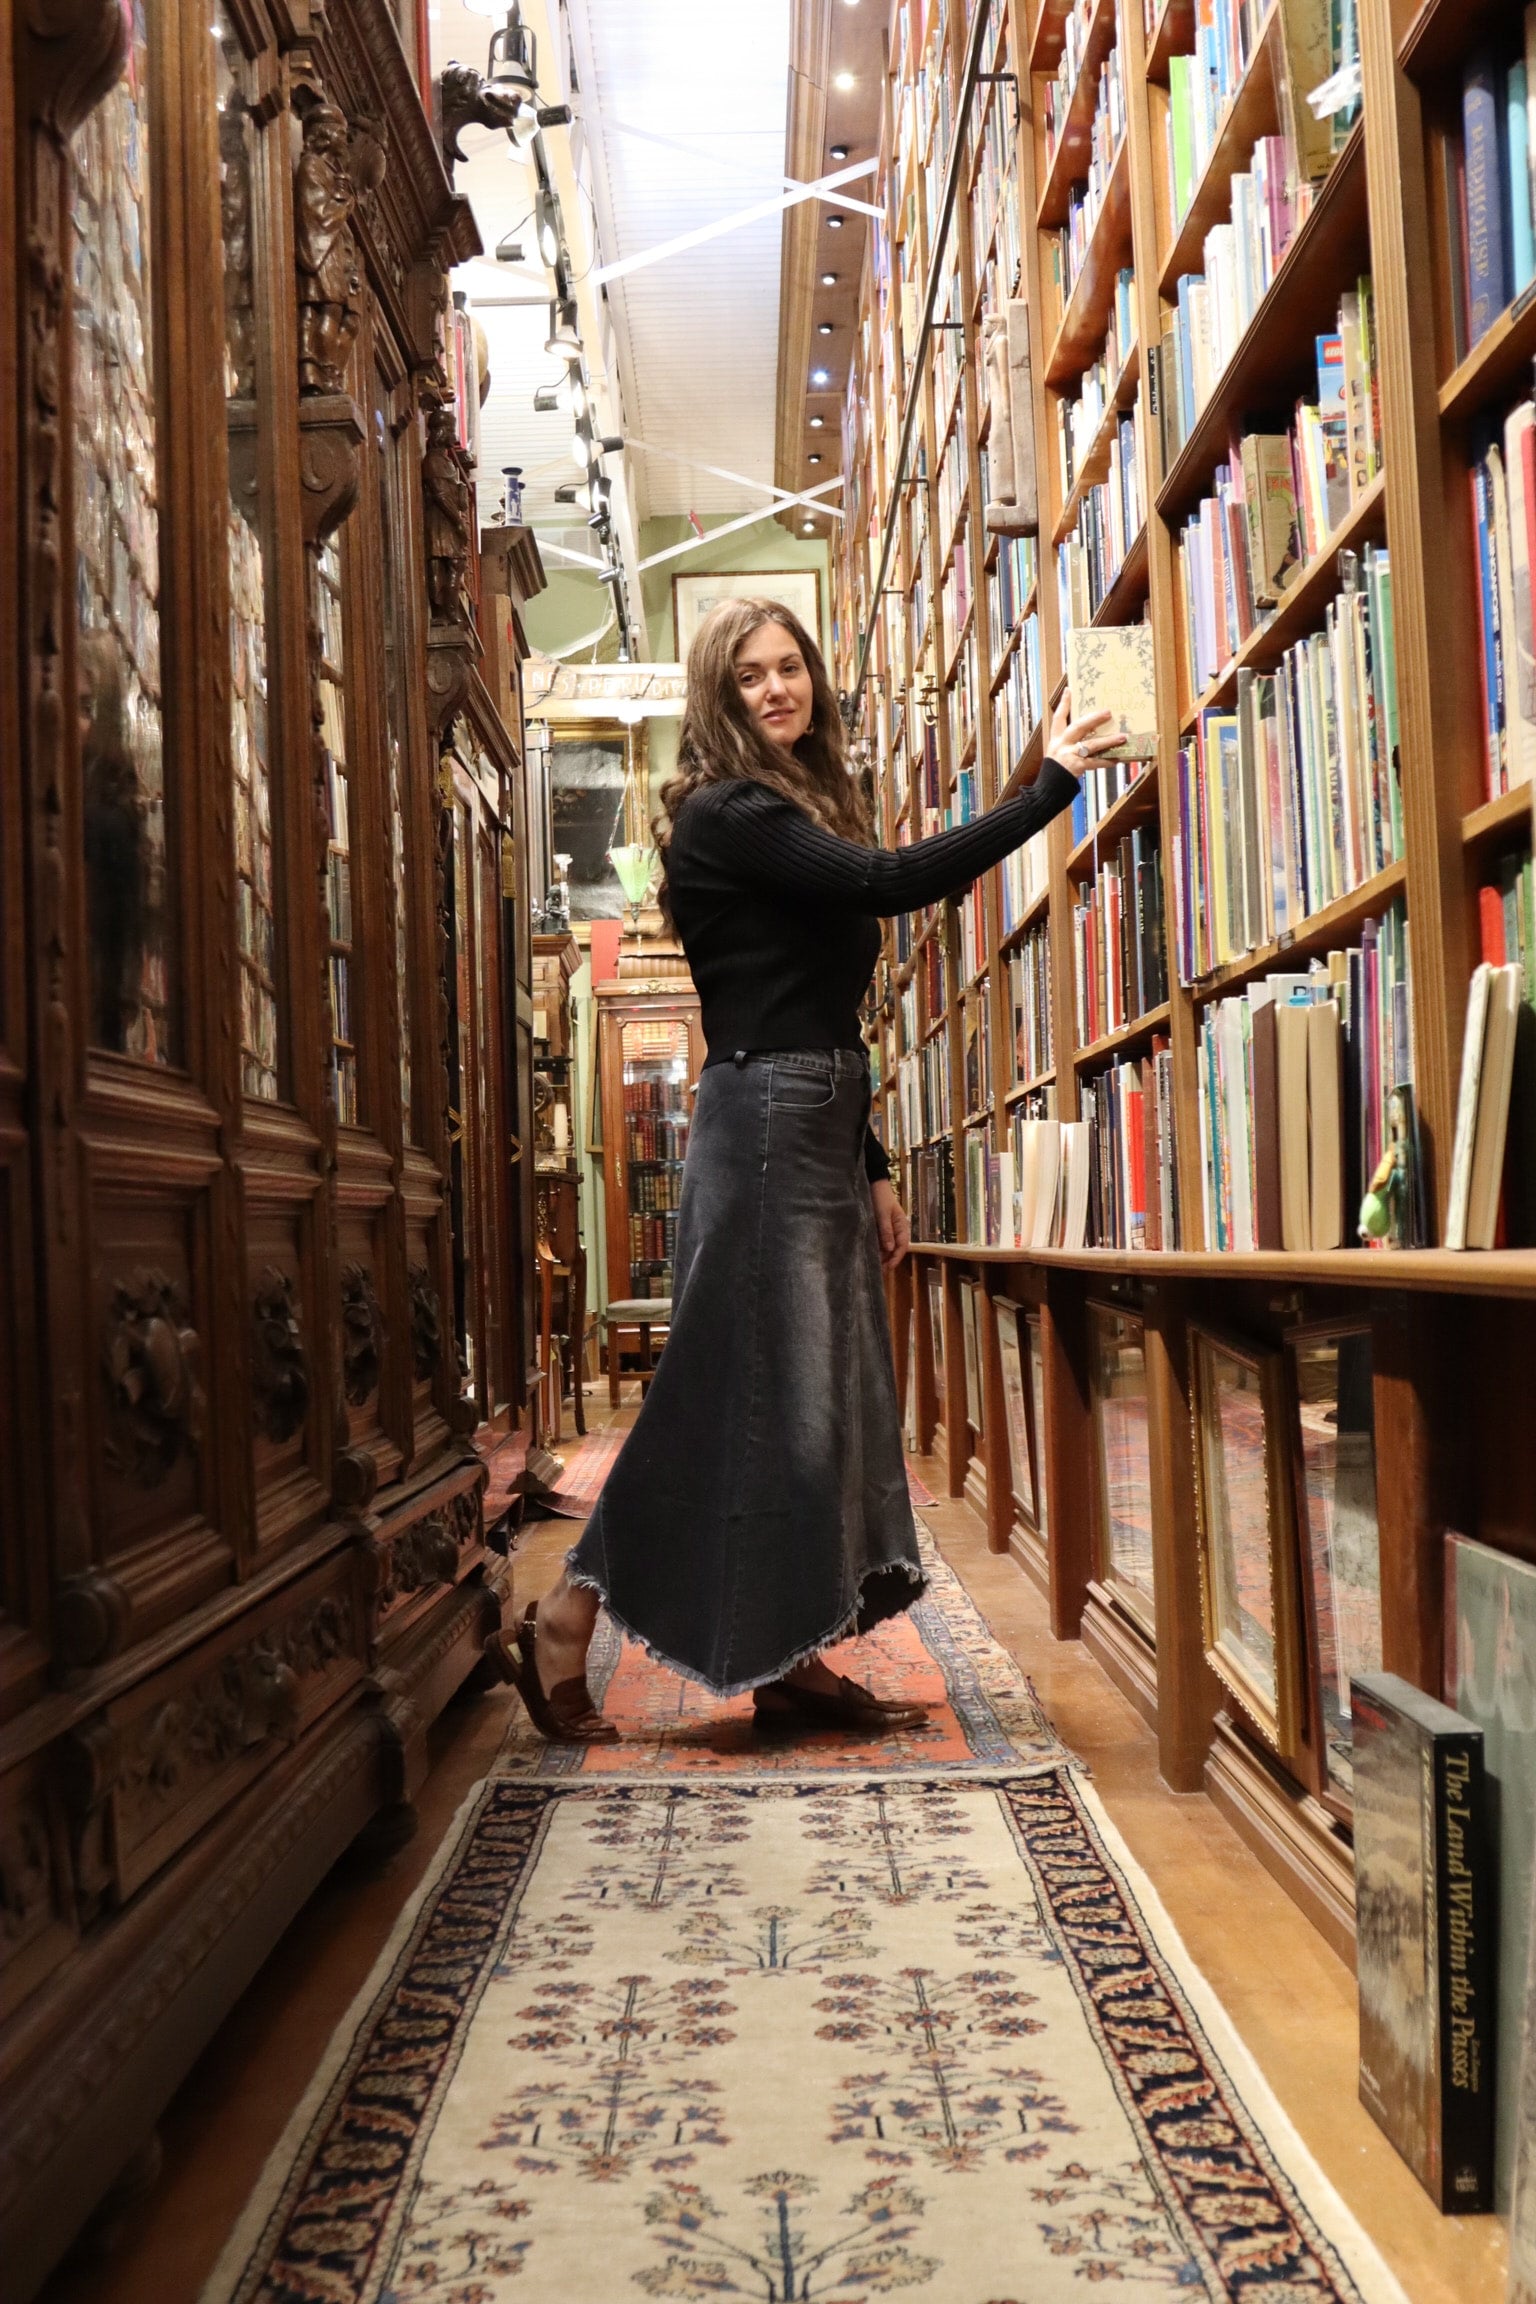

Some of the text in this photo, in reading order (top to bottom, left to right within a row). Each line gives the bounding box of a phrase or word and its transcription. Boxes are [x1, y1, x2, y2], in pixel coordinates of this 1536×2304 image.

[1445, 1751, 1476, 2089] The Land Within the Passes
